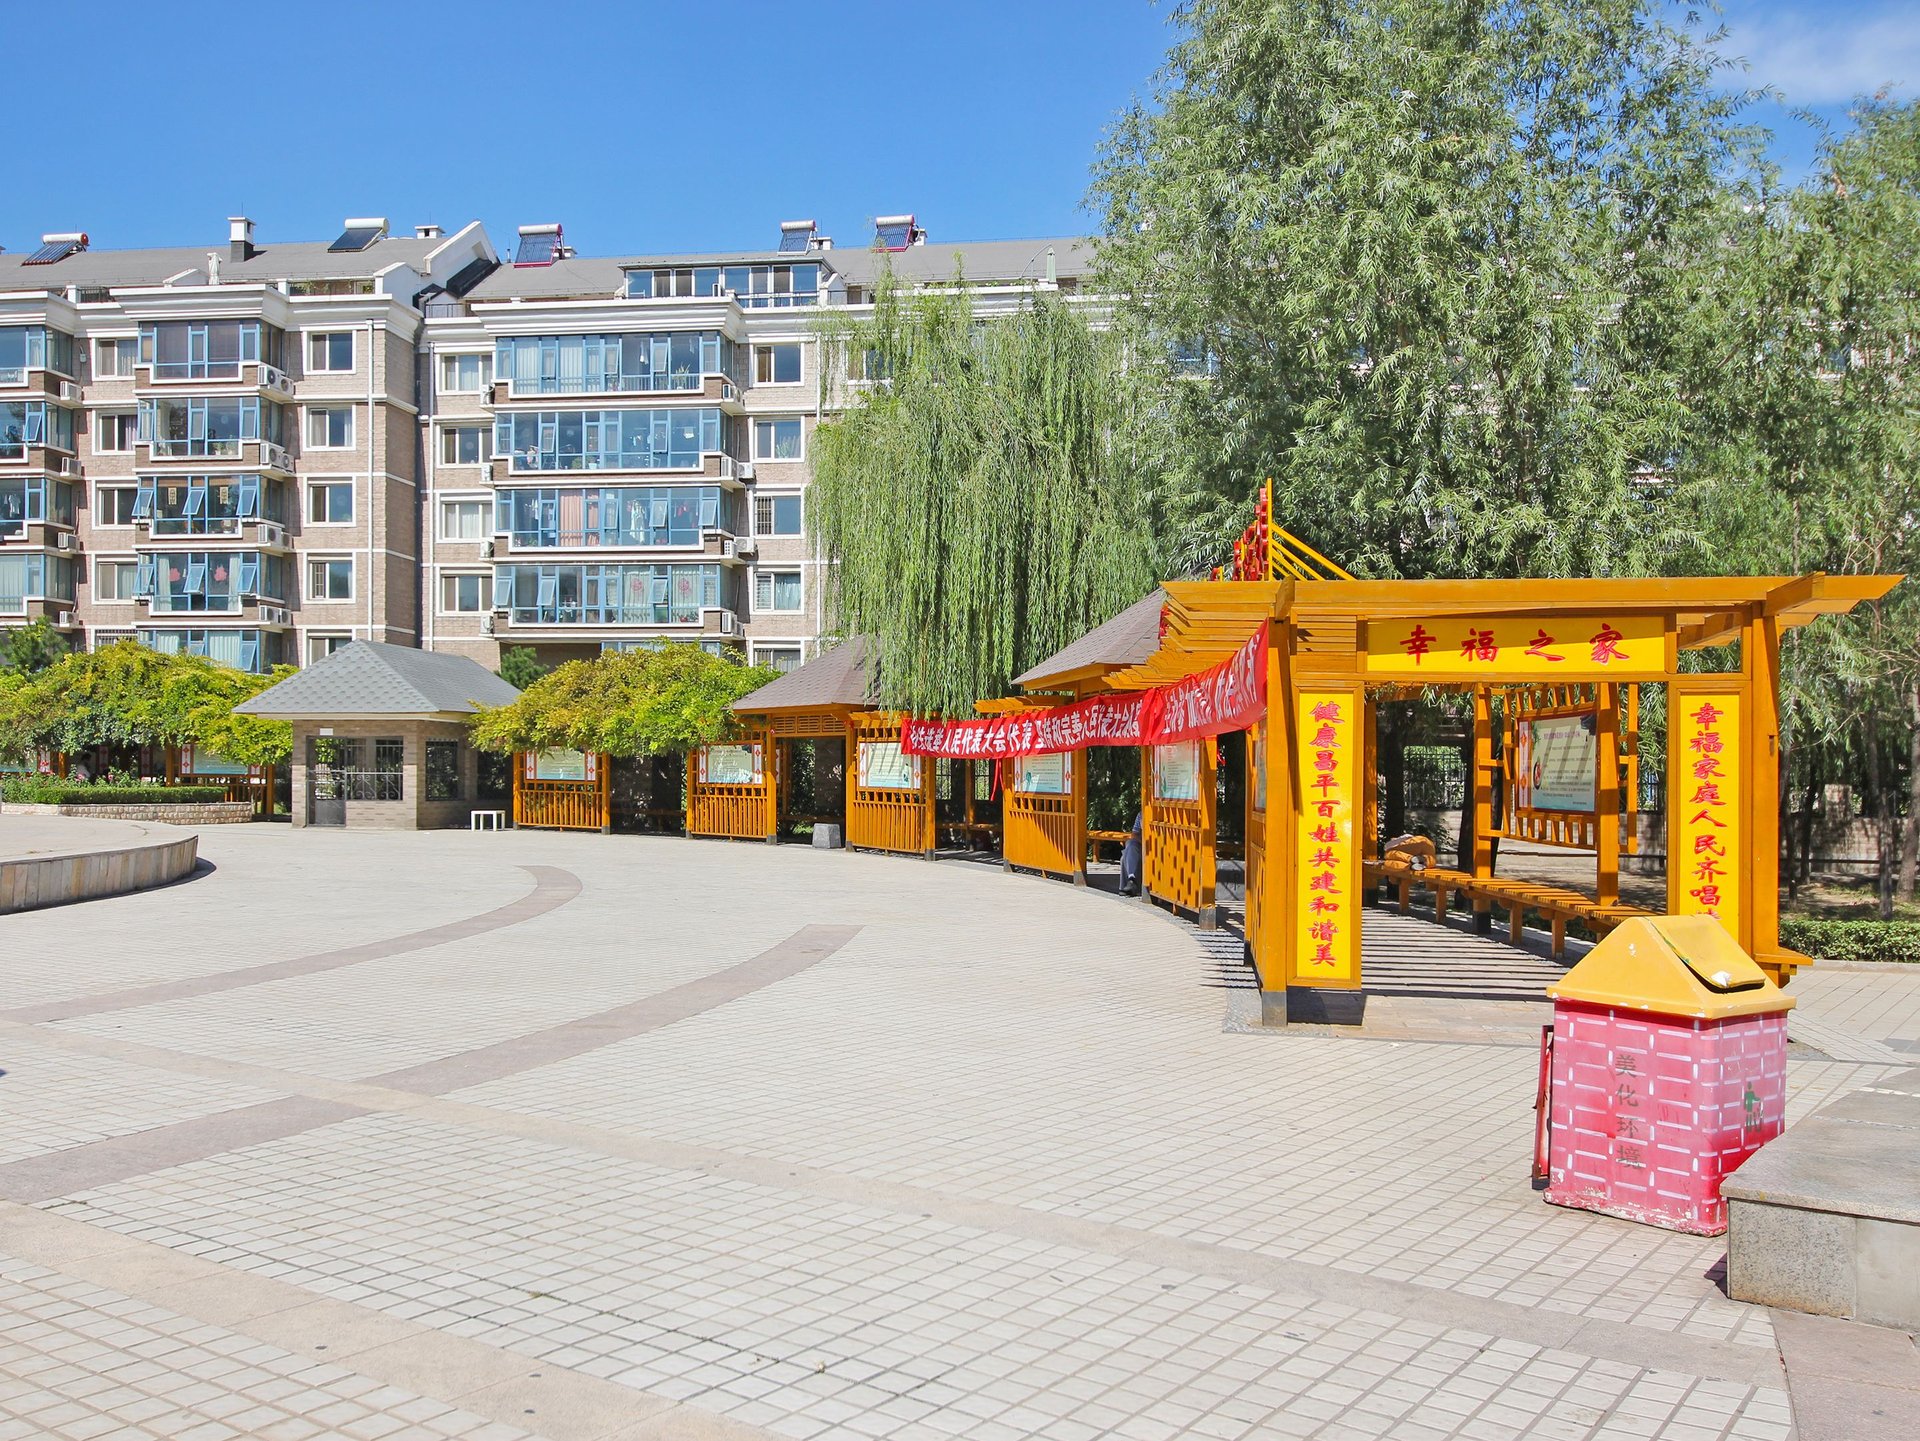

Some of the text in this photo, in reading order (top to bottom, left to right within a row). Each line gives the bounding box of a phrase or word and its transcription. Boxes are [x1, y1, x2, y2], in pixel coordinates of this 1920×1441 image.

[1400, 623, 1630, 666] 幸福之家
[1308, 700, 1346, 967] 健康昌平百姓共建和谐美
[1615, 1054, 1645, 1170] 美化环境
